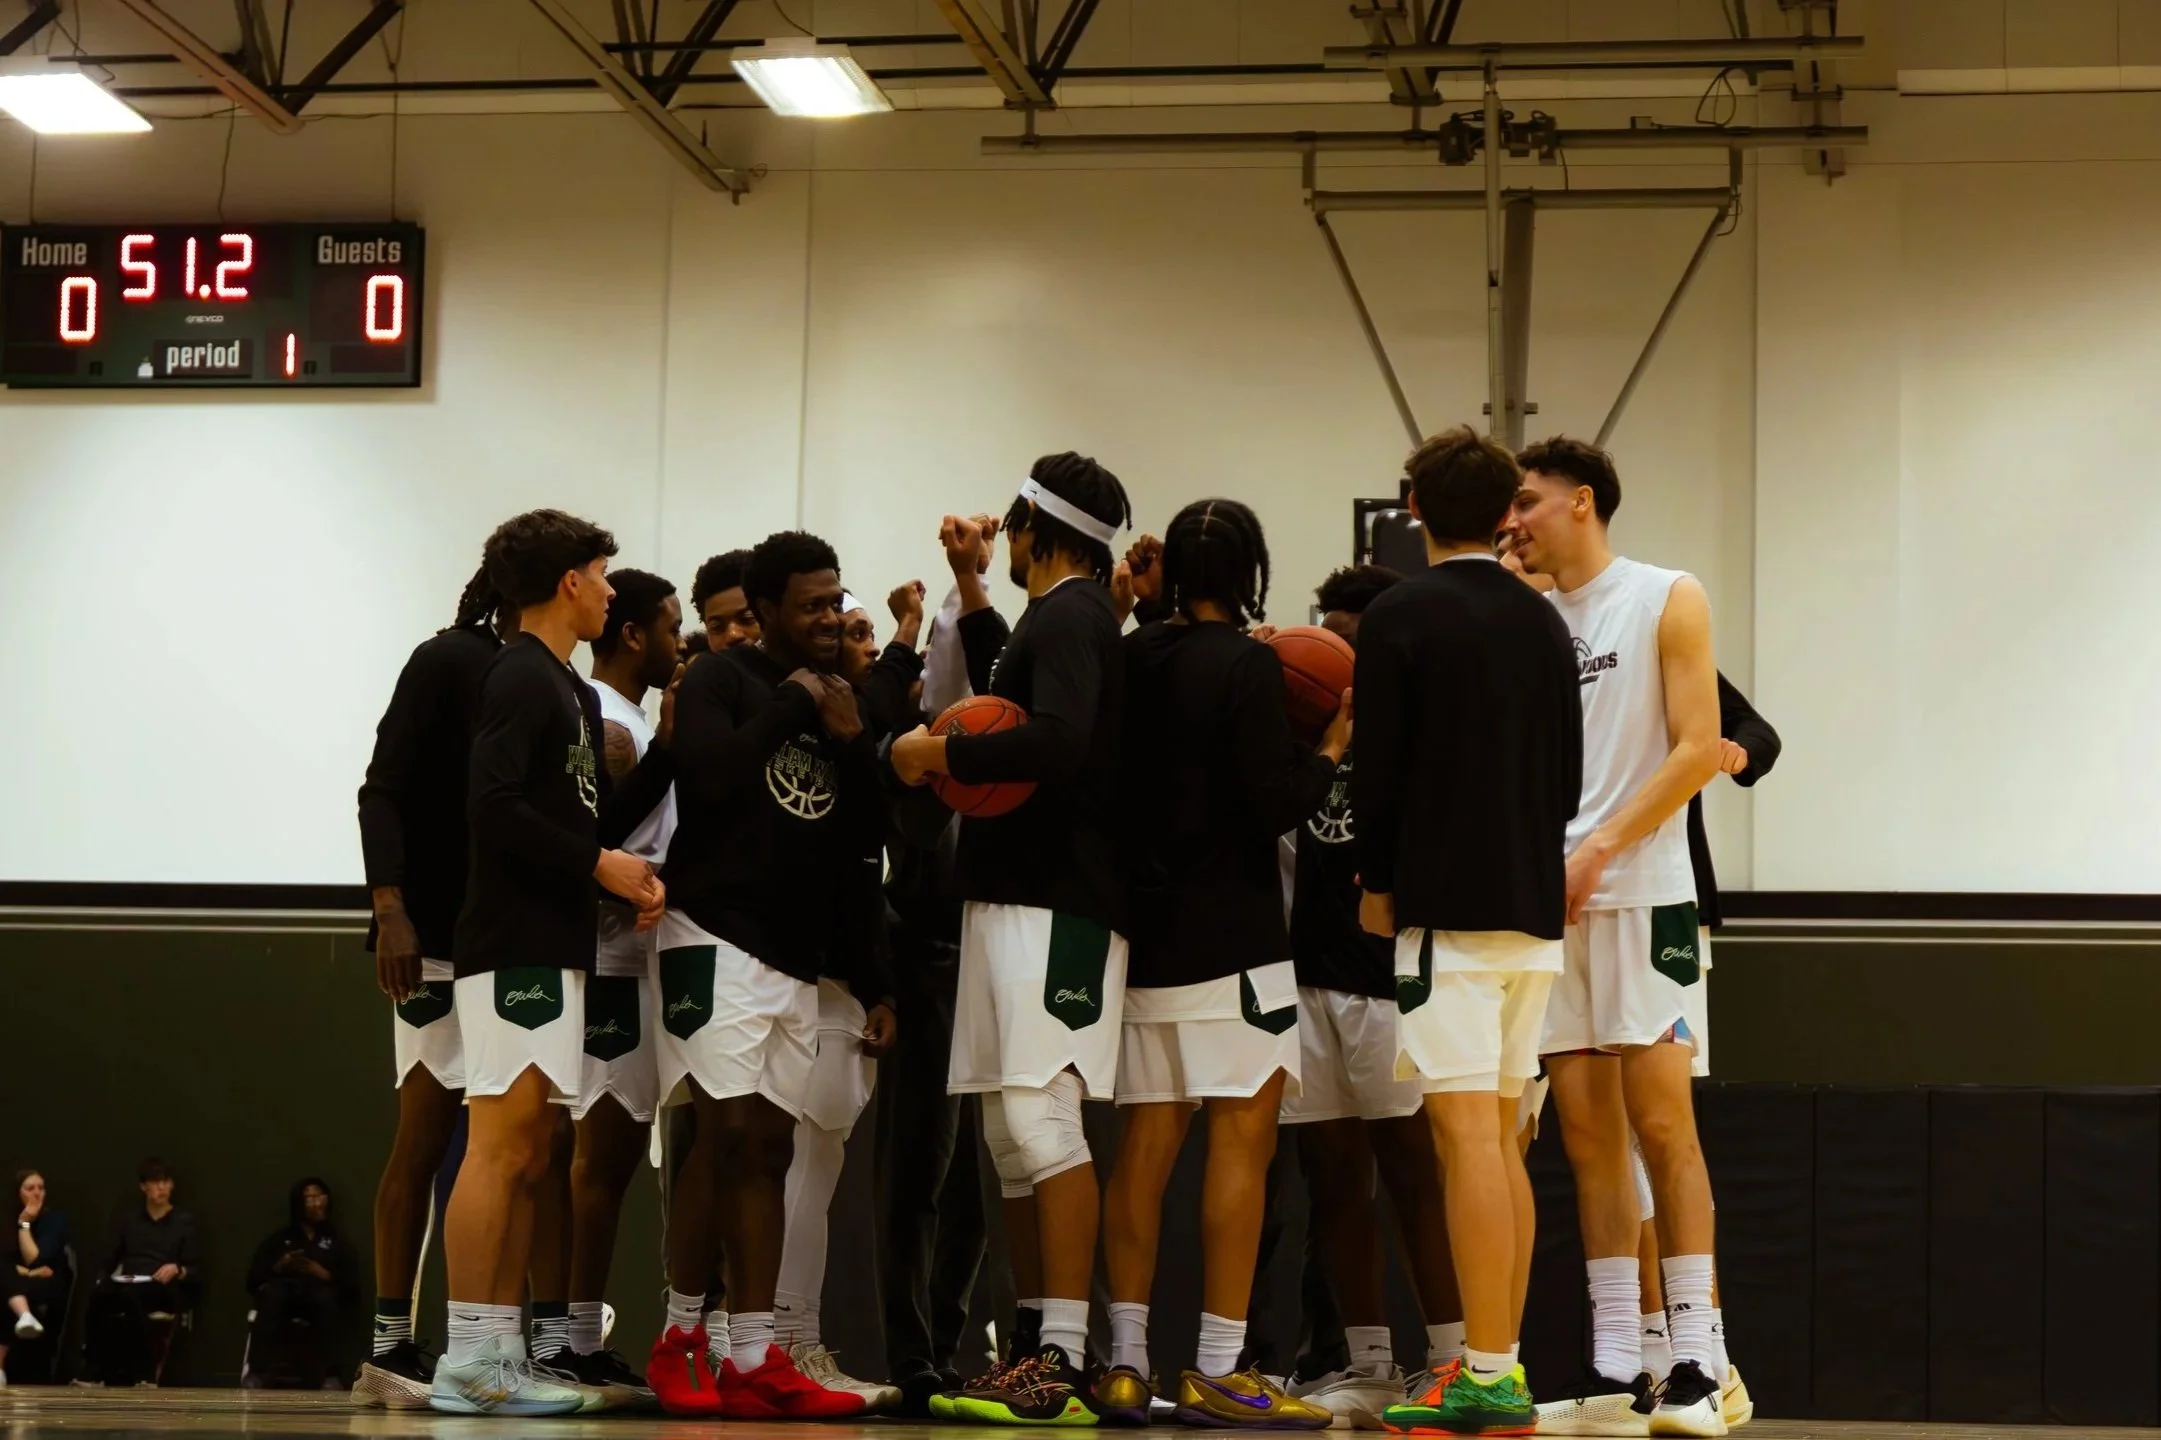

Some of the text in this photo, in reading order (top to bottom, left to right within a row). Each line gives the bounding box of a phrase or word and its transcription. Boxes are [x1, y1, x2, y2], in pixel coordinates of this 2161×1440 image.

[22, 237, 87, 266] Home
[121, 234, 253, 298] 51.2
[317, 235, 402, 265] Guests
[60, 276, 97, 341] 0
[366, 275, 403, 340] 0
[166, 340, 240, 374] period
[286, 333, 296, 377] 1
